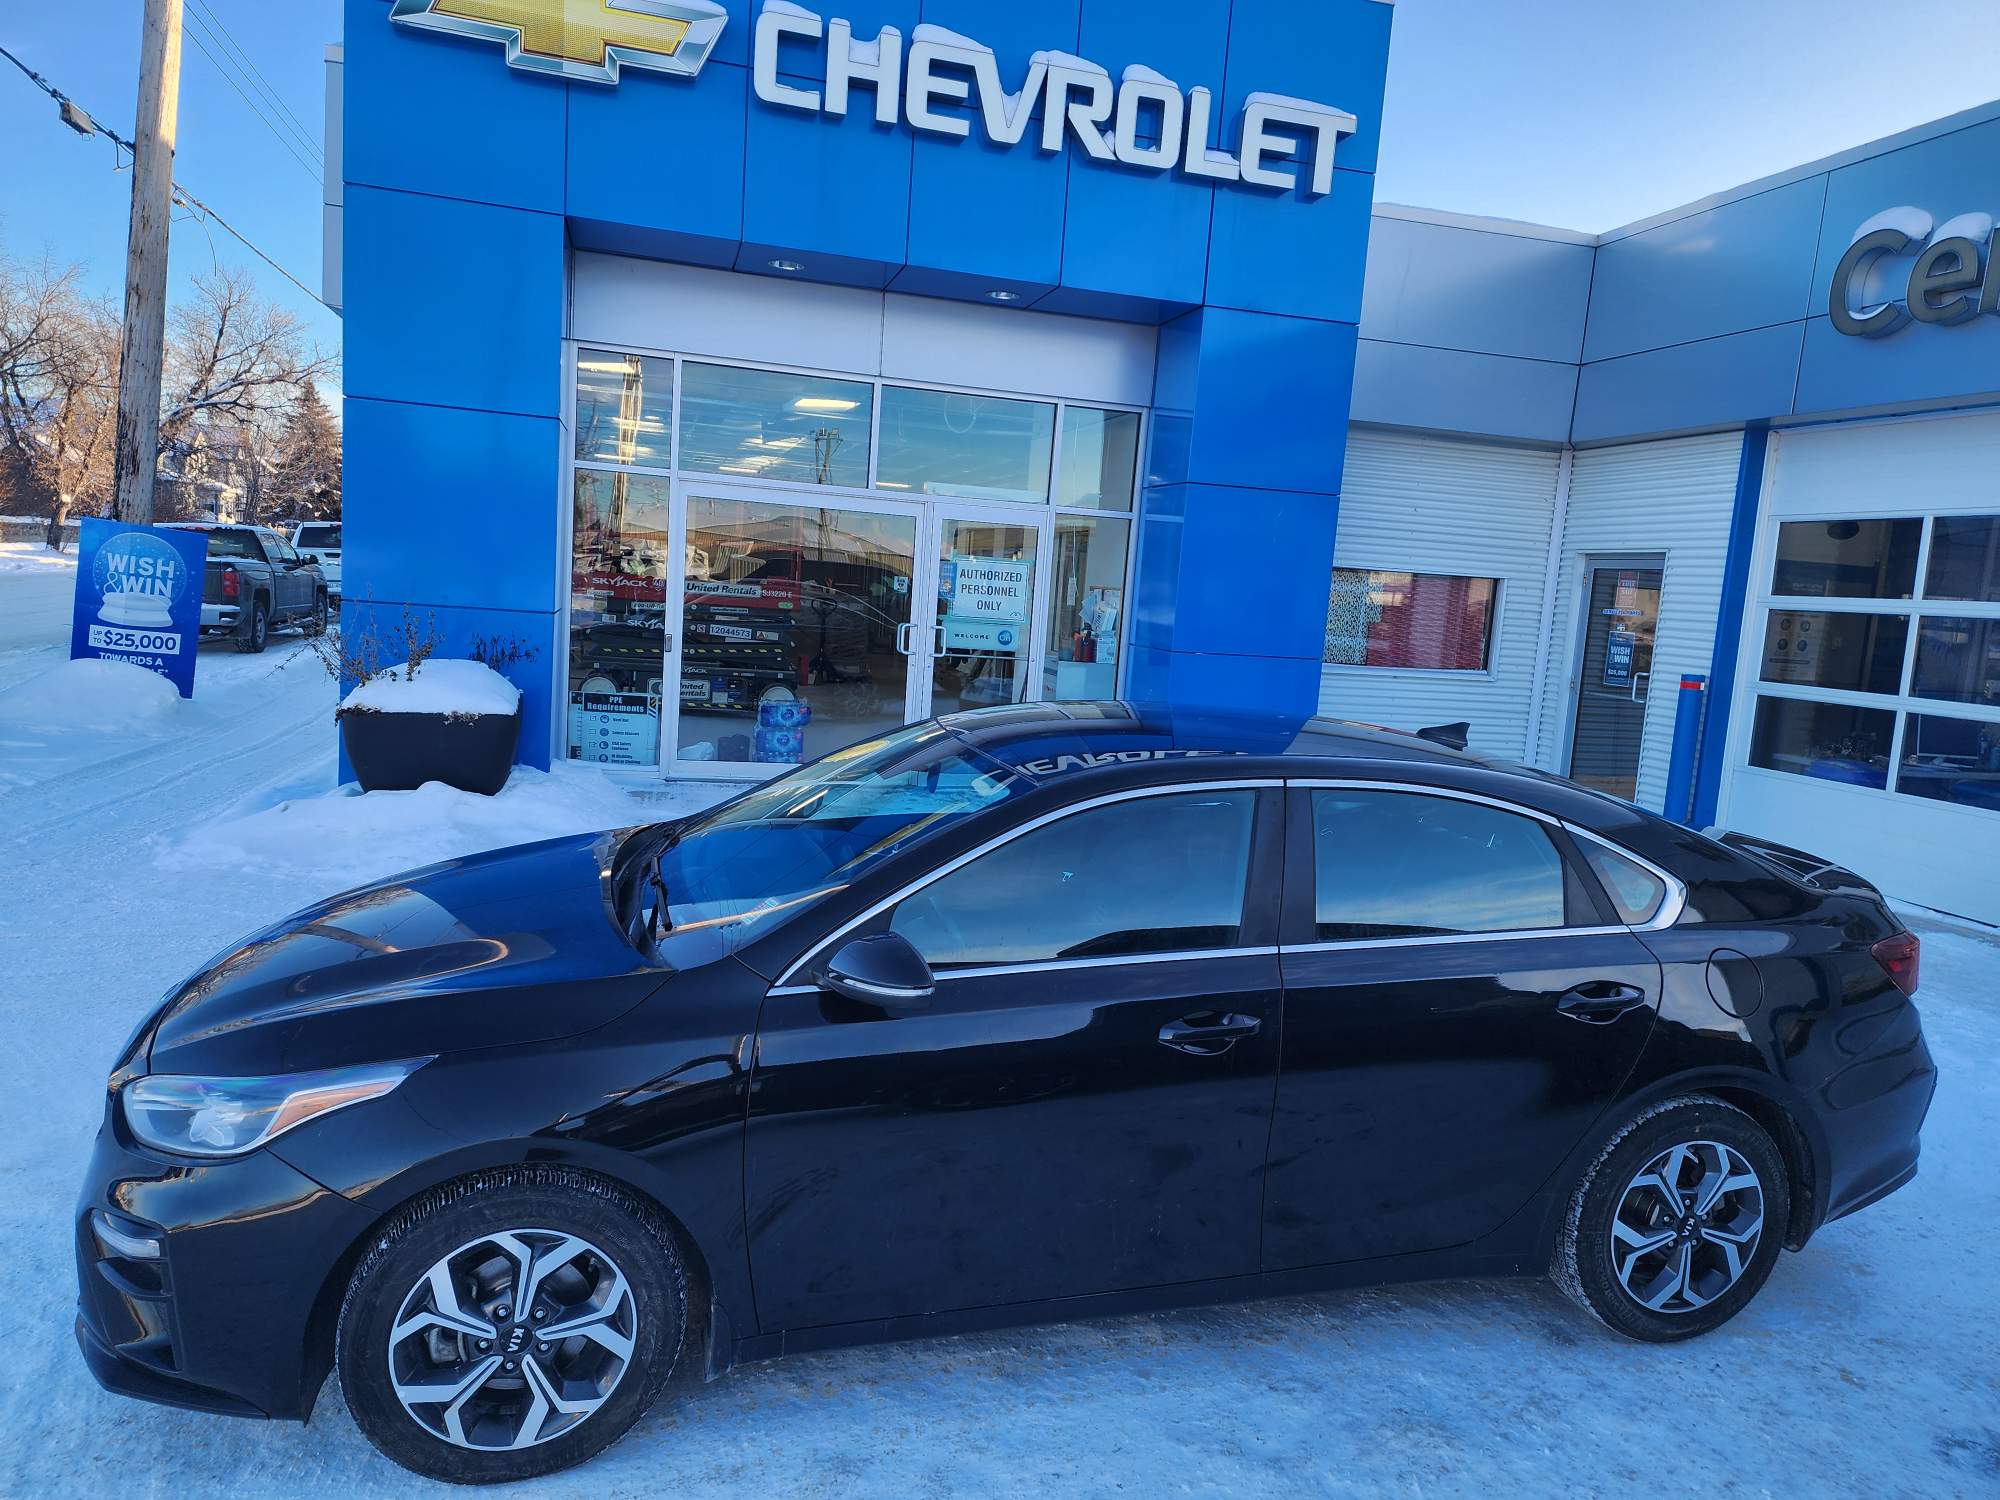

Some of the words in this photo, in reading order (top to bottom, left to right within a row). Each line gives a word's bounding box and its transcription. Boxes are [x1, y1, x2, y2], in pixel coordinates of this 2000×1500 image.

[753, 11, 1357, 196] CHEVROLET
[107, 553, 174, 578] WISH
[591, 575, 648, 587] SKYJACK
[960, 568, 1023, 582] AUTHORIZED
[686, 582, 719, 592] United
[721, 585, 757, 596] Rentals
[961, 584, 1019, 598] PERSONNEL
[976, 600, 1002, 611] ONLY
[627, 618, 665, 629] SKYJA
[710, 625, 750, 638] 12044573
[103, 629, 176, 650] $25,000
[1610, 646, 1630, 655] WISH
[155, 656, 163, 666] A
[681, 682, 704, 690] nited
[609, 695, 623, 704] PPE
[586, 702, 645, 713] Requirements
[1681, 1217, 1696, 1236] KIA
[507, 1327, 525, 1352] KIA
